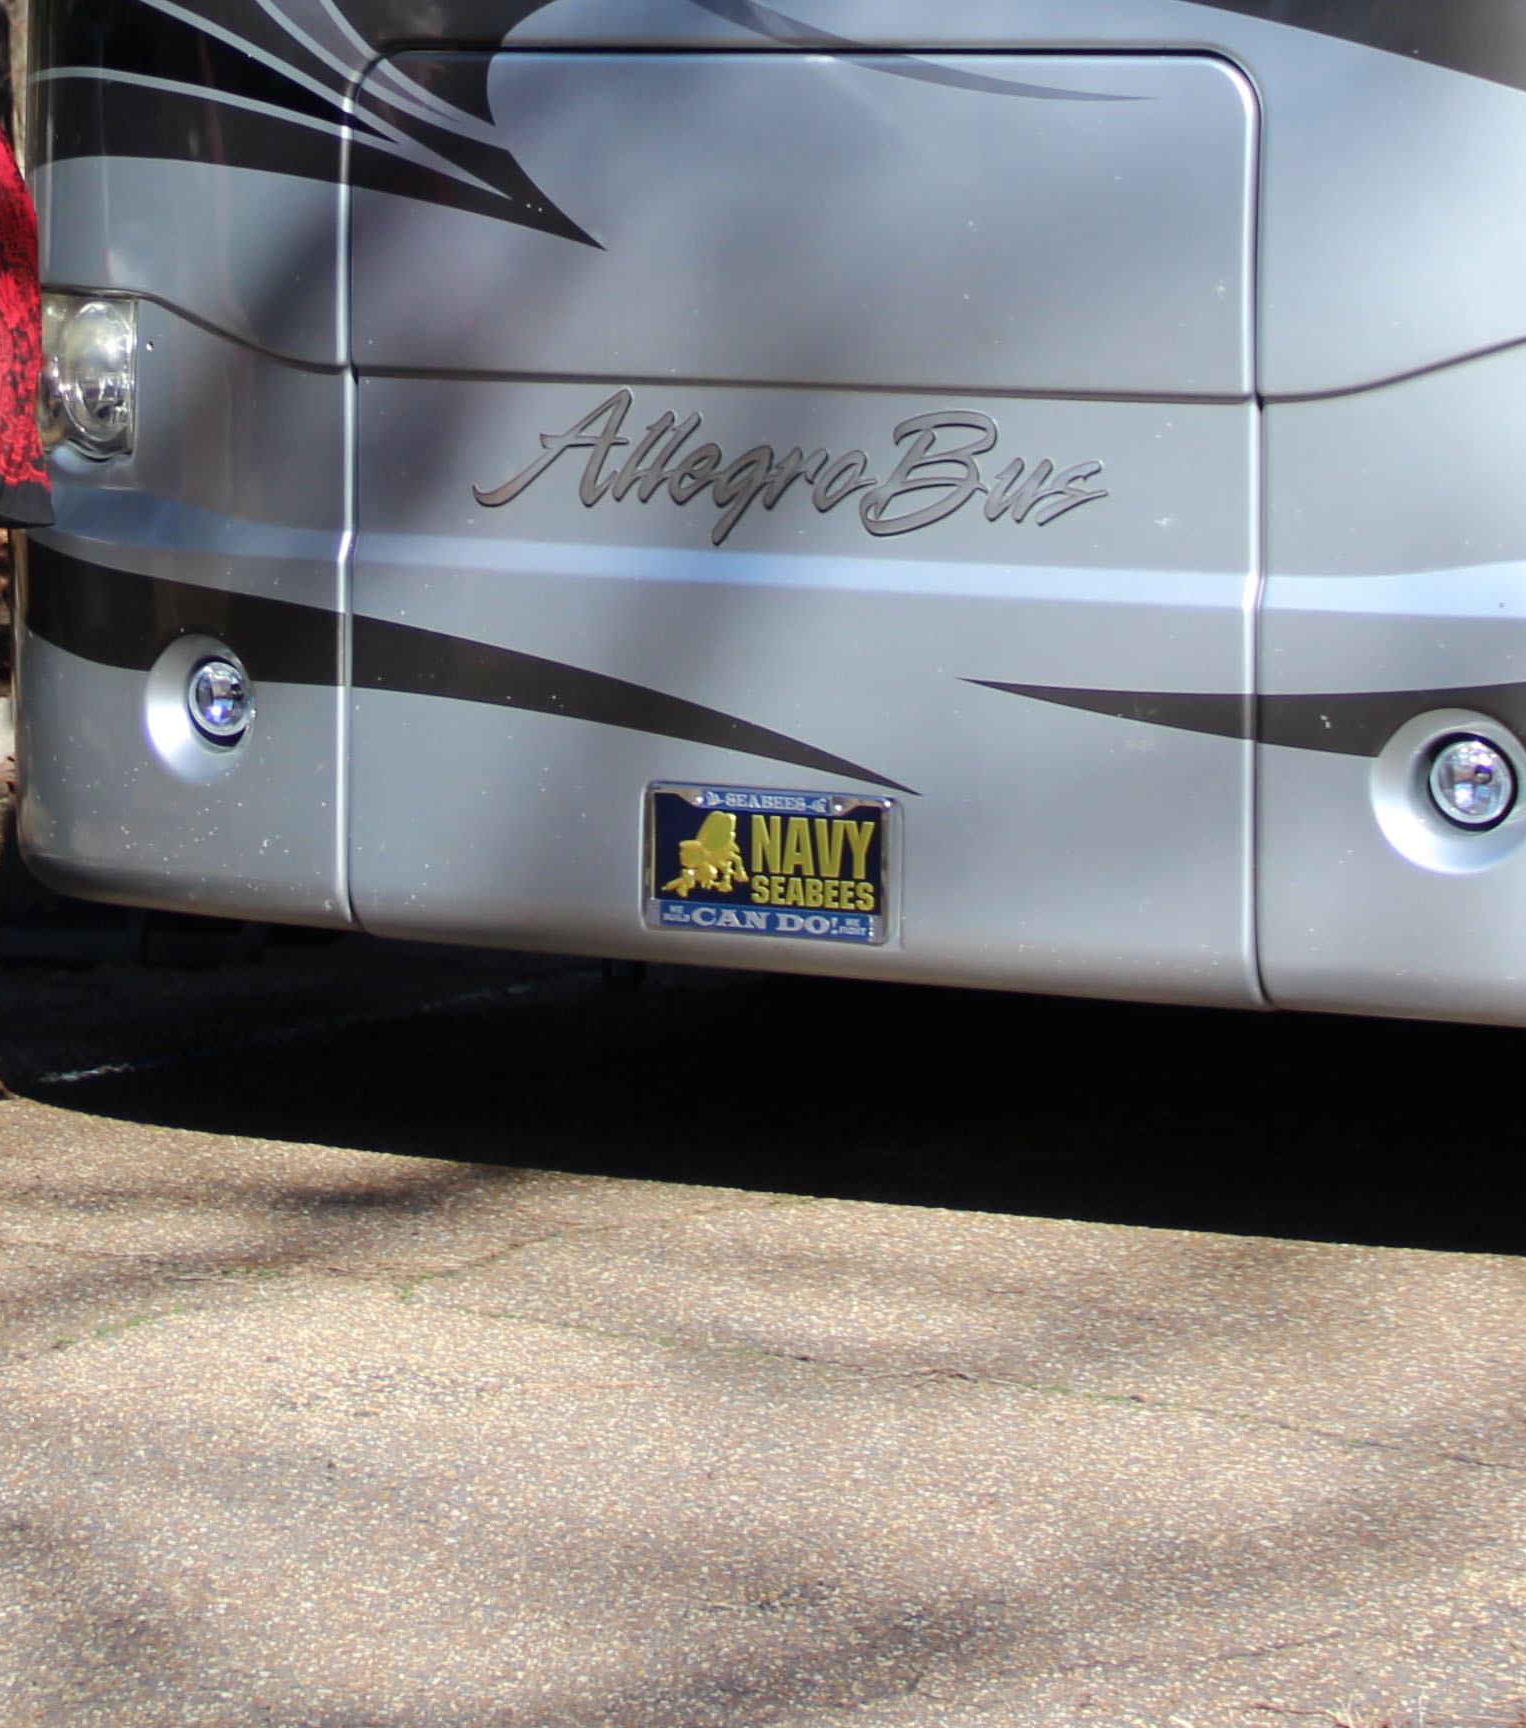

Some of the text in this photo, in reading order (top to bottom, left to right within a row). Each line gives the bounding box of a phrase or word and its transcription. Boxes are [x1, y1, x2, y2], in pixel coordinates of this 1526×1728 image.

[724, 792, 807, 812] SEABEES
[751, 814, 875, 880] NAVY
[751, 875, 875, 912] SEABEES
[691, 906, 839, 936] CAN DO!
